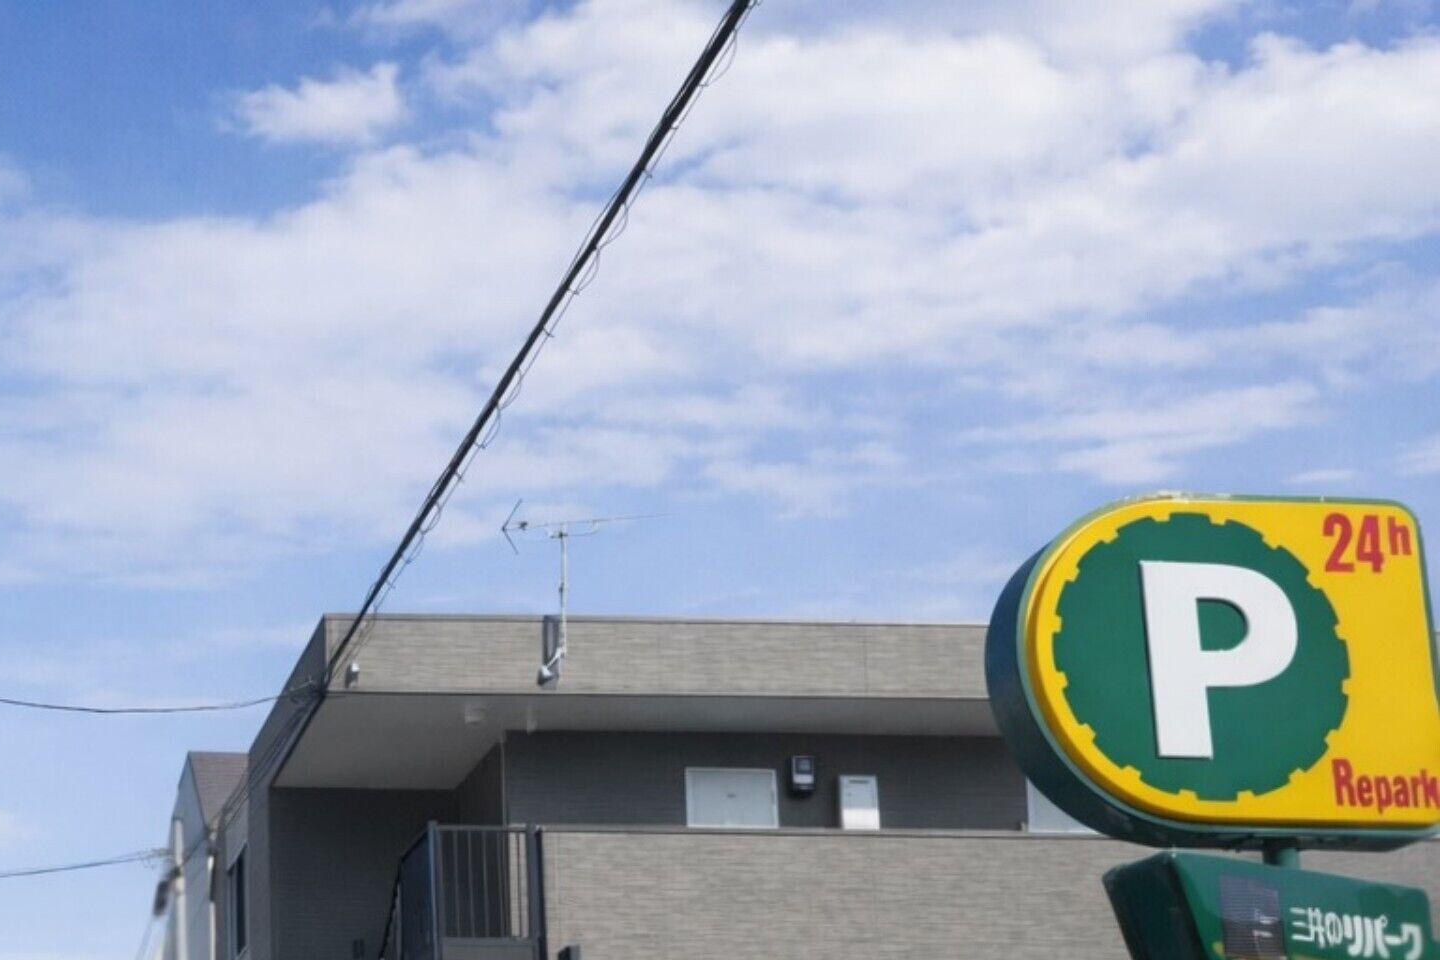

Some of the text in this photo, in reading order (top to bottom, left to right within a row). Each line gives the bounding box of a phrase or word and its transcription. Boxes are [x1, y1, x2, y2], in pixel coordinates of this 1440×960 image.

[1322, 513, 1412, 574] 24h
[1139, 559, 1299, 760] P
[1331, 757, 1440, 815] Repark
